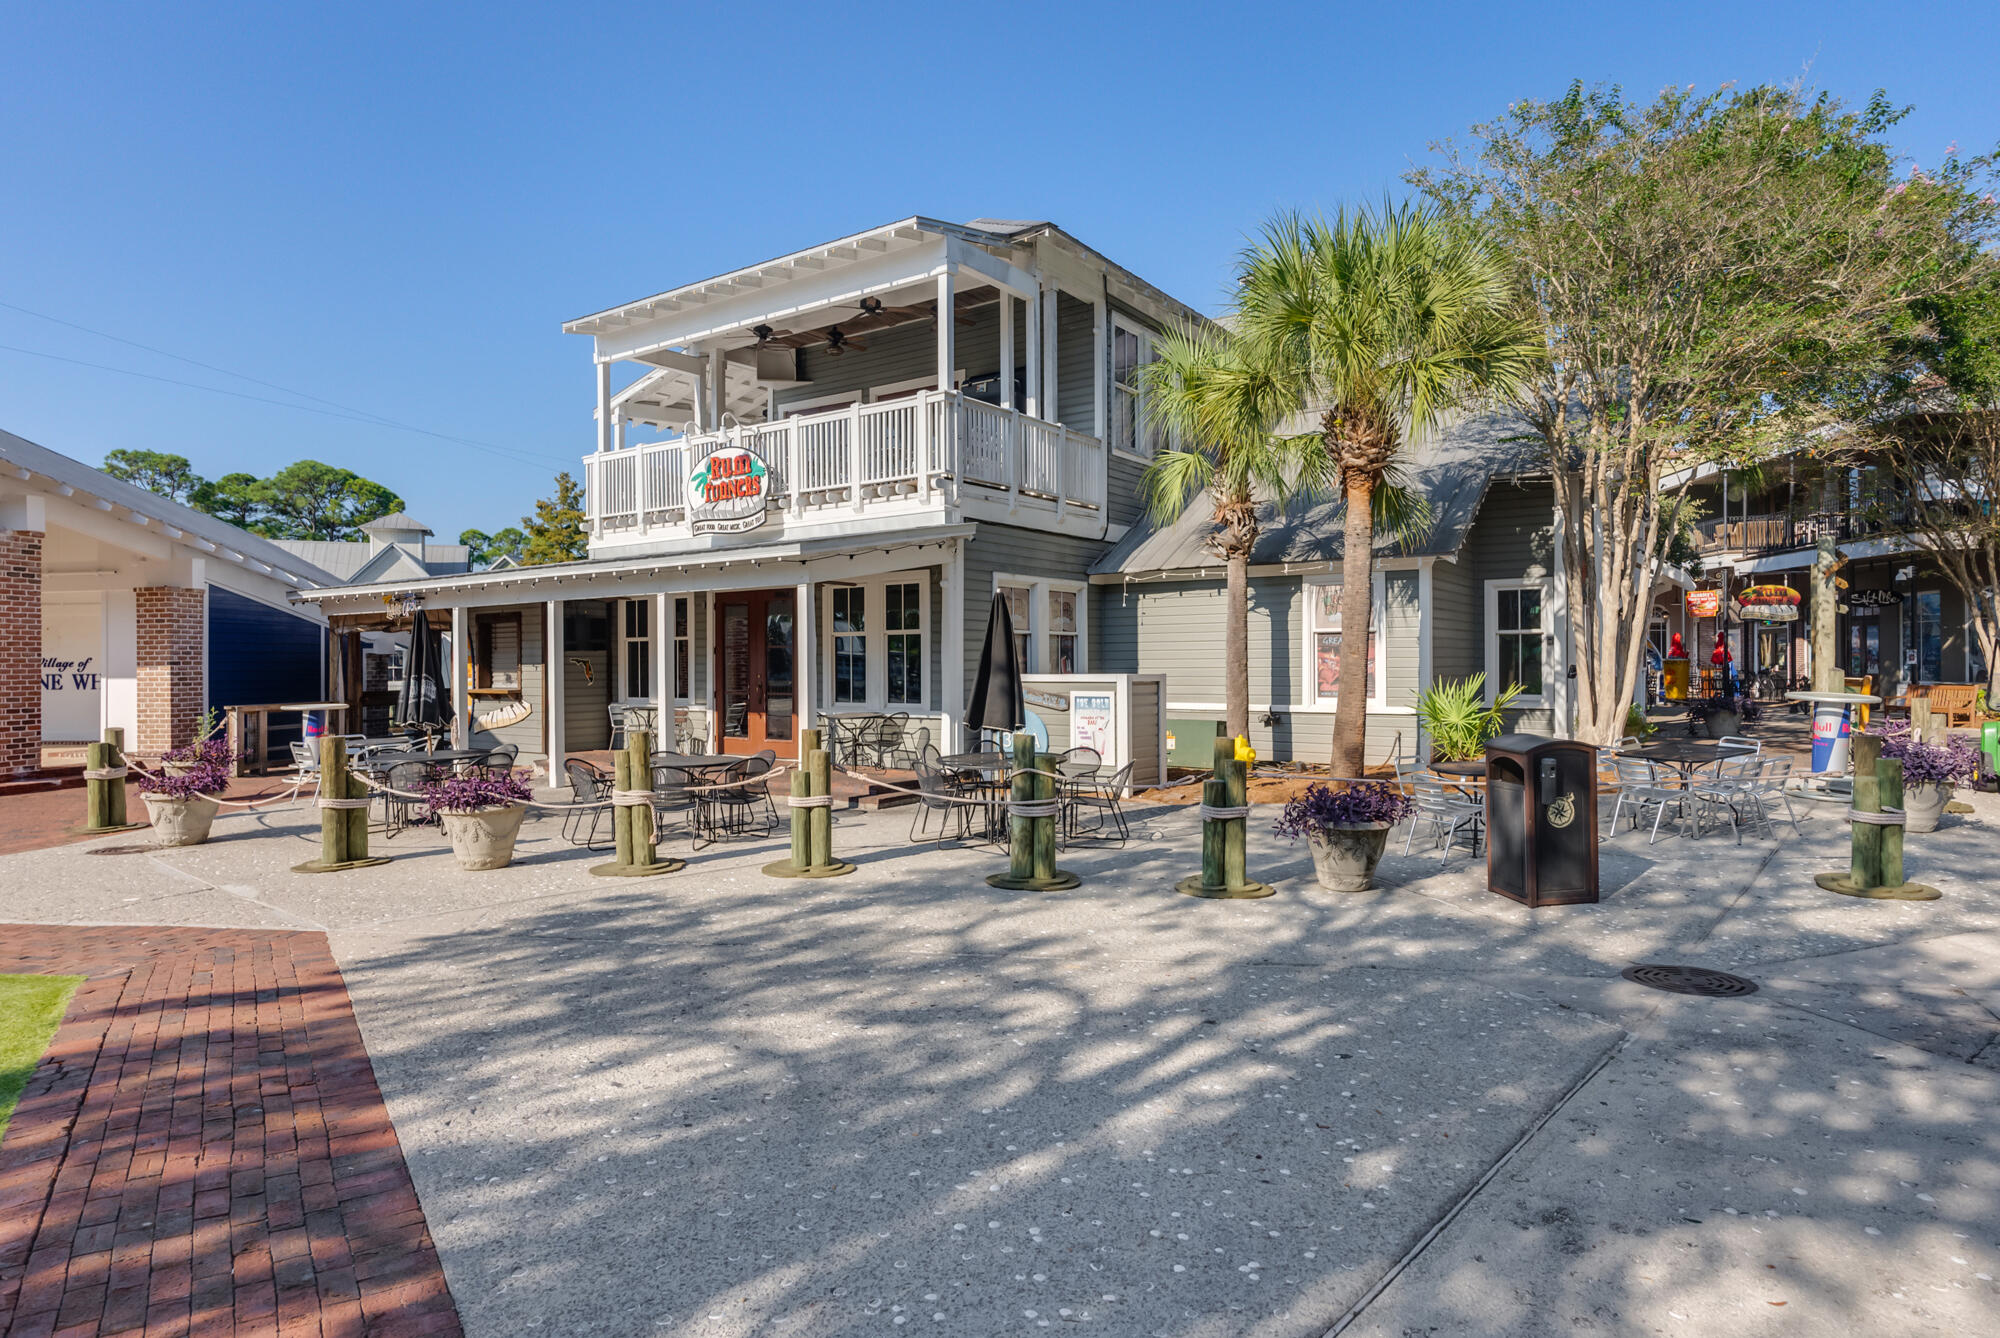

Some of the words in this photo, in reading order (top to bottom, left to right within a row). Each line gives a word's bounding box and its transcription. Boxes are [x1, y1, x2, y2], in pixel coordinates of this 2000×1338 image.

[1322, 637, 1343, 645] GREA
[41, 657, 75, 673] illage
[77, 657, 93, 673] of
[41, 674, 64, 690] NE
[72, 674, 101, 690] WH
